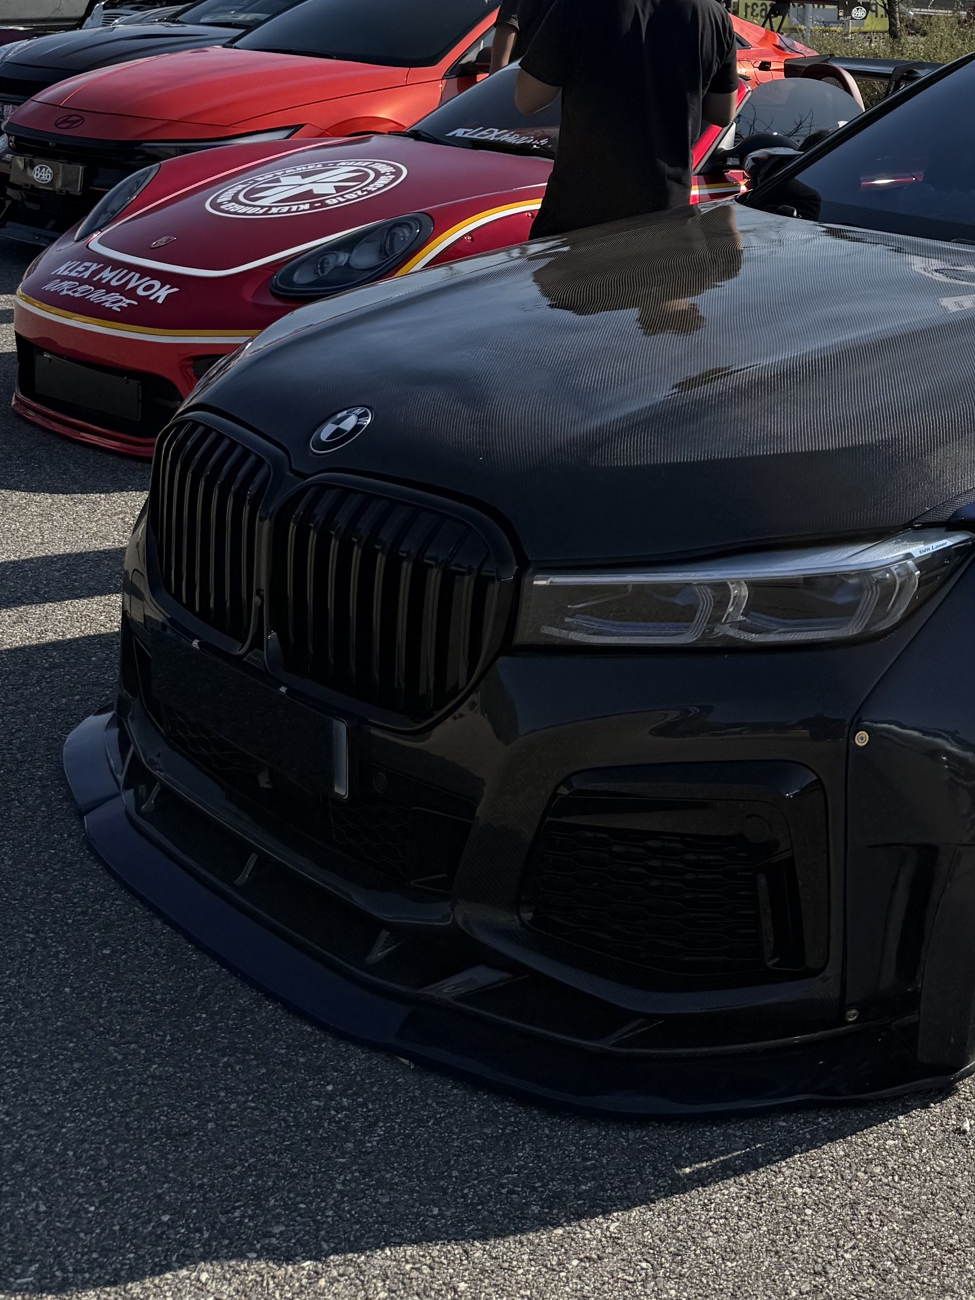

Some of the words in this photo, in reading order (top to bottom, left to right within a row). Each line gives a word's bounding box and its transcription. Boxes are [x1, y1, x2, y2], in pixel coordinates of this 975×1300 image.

[268, 202, 310, 214] KLEX
[51, 260, 104, 279] KLEX
[93, 265, 180, 304] MUVOK
